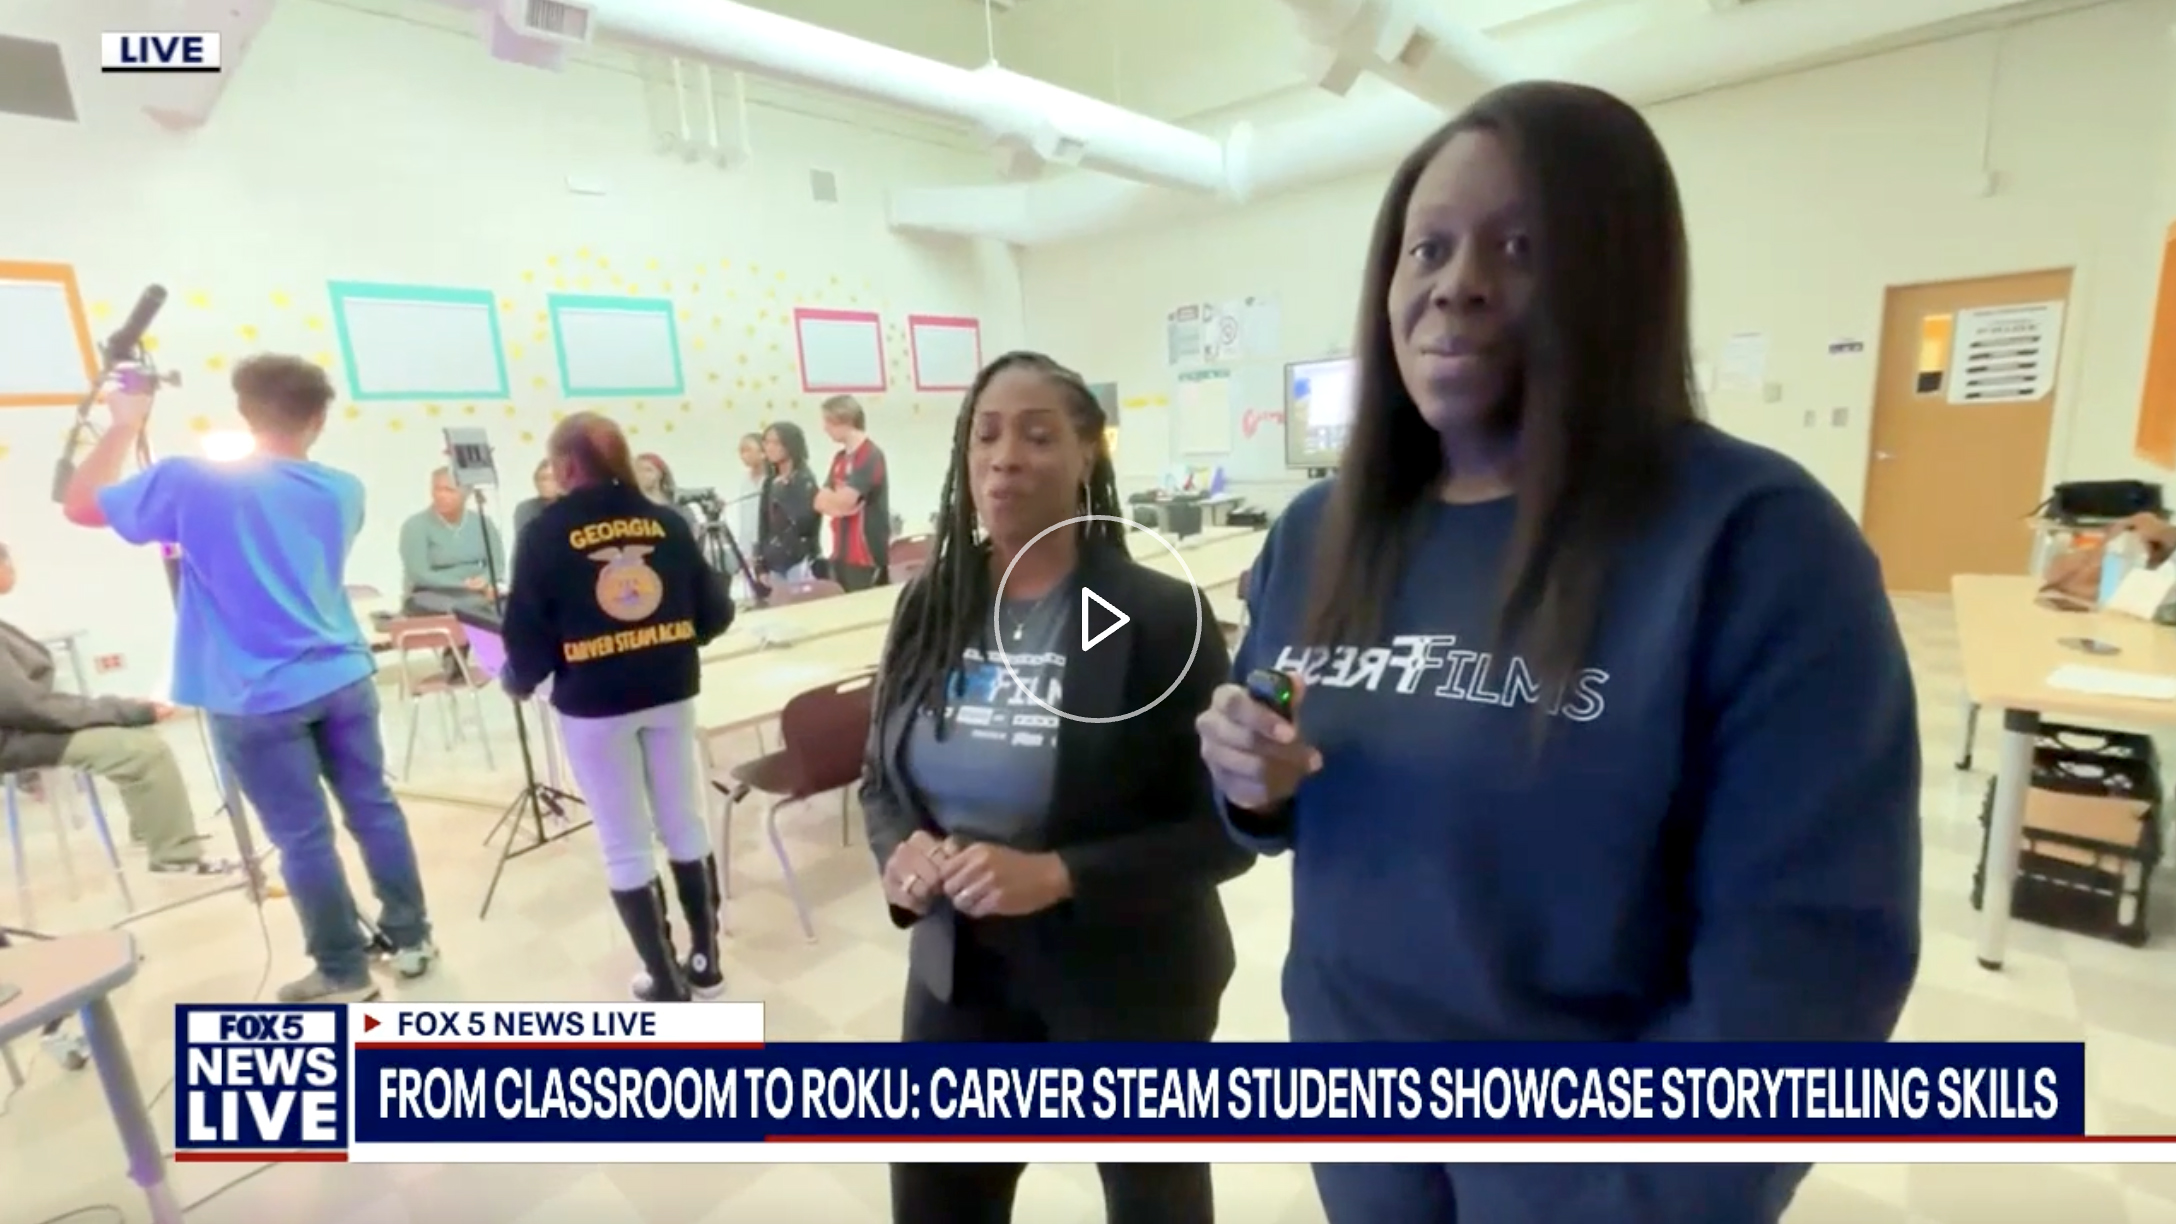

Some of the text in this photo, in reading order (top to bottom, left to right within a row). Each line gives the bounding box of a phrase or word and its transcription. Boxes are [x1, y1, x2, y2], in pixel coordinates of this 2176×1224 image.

[569, 517, 667, 550] GEORGIA
[563, 634, 615, 664] CARVER
[615, 625, 658, 652] STEAM
